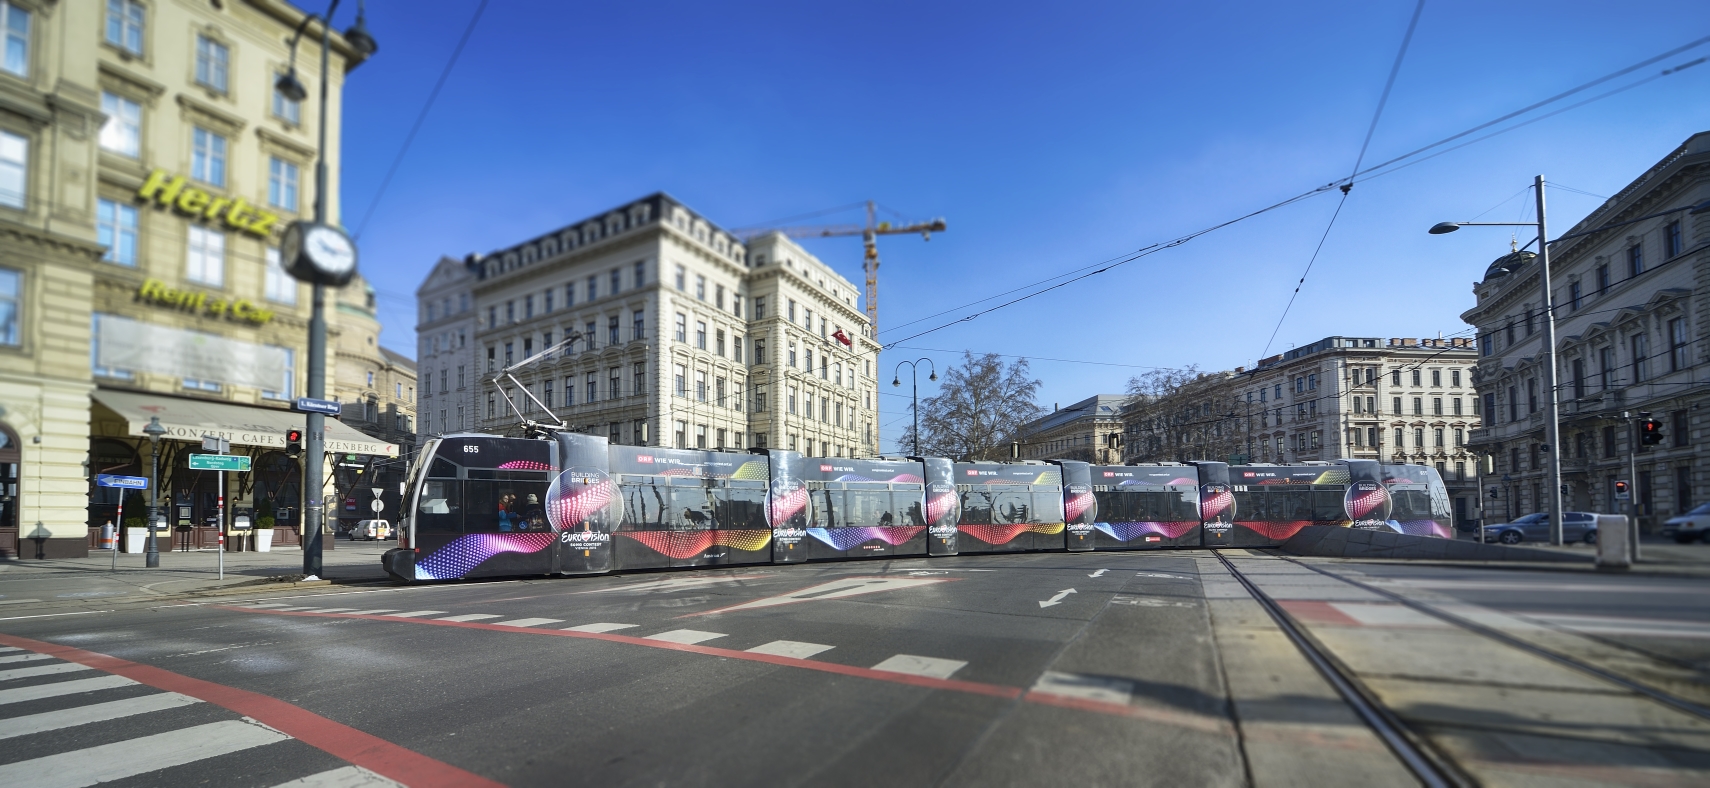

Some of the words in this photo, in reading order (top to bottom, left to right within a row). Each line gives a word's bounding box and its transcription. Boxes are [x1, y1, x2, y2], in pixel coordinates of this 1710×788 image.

[139, 168, 279, 236] Hertz
[140, 277, 207, 309] Rent
[210, 298, 228, 315] a
[232, 299, 274, 323] Car
[167, 426, 235, 441] KONZERT
[242, 433, 274, 444] CAFE
[463, 445, 479, 454] 655
[114, 478, 143, 486] EINBAHN
